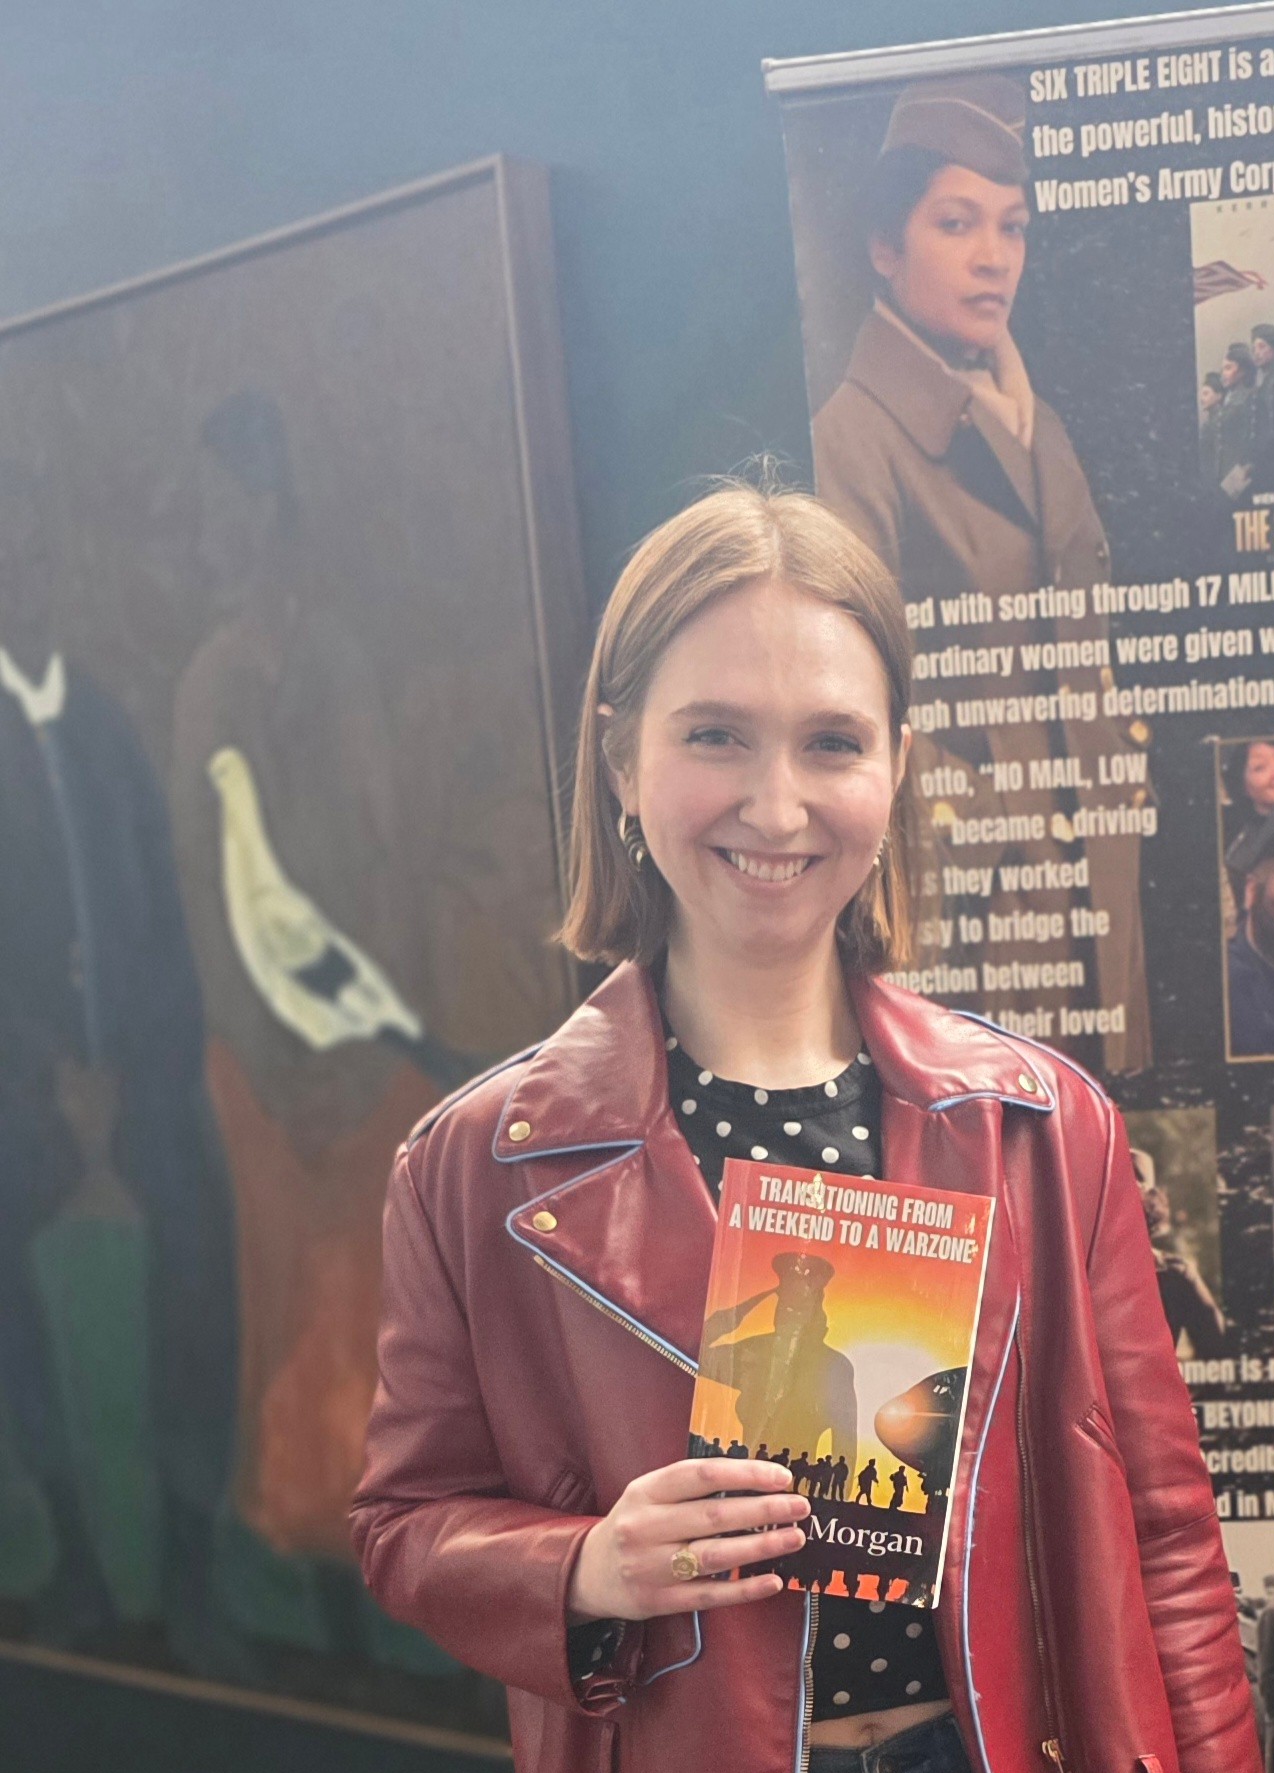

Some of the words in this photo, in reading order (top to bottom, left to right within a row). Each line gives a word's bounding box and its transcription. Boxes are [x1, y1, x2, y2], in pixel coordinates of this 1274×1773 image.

[1029, 67, 1067, 103] SIX
[1073, 57, 1150, 97] TRIPLE
[1156, 49, 1221, 89] EIGHT
[1031, 123, 1074, 158] the
[1079, 108, 1201, 158] powerful,
[1157, 166, 1223, 201] Army
[1232, 509, 1271, 552] THE
[939, 591, 993, 626] with
[997, 584, 1086, 622] sorting
[1091, 576, 1190, 615] through
[1194, 574, 1222, 607] 17
[1019, 637, 1110, 675] women
[1115, 633, 1178, 664] were
[1184, 626, 1253, 663] given
[955, 688, 1098, 727] unwavering
[1097, 752, 1147, 785] LOW
[952, 814, 1046, 846] became
[1072, 803, 1158, 837] driving
[941, 864, 993, 897] they
[998, 856, 1089, 892] worked
[987, 908, 1065, 943] bridge
[1069, 906, 1110, 937] the
[981, 960, 1084, 992] between
[1058, 1002, 1126, 1036] loved
[759, 1174, 898, 1221] TRANSITIONING
[901, 1197, 953, 1229] FROM
[727, 1202, 741, 1229] A
[748, 1204, 834, 1242] WEEKEND
[839, 1218, 862, 1247] TO
[865, 1222, 878, 1249] A
[885, 1228, 976, 1264] WARZONE
[806, 1514, 924, 1557] Morgan
